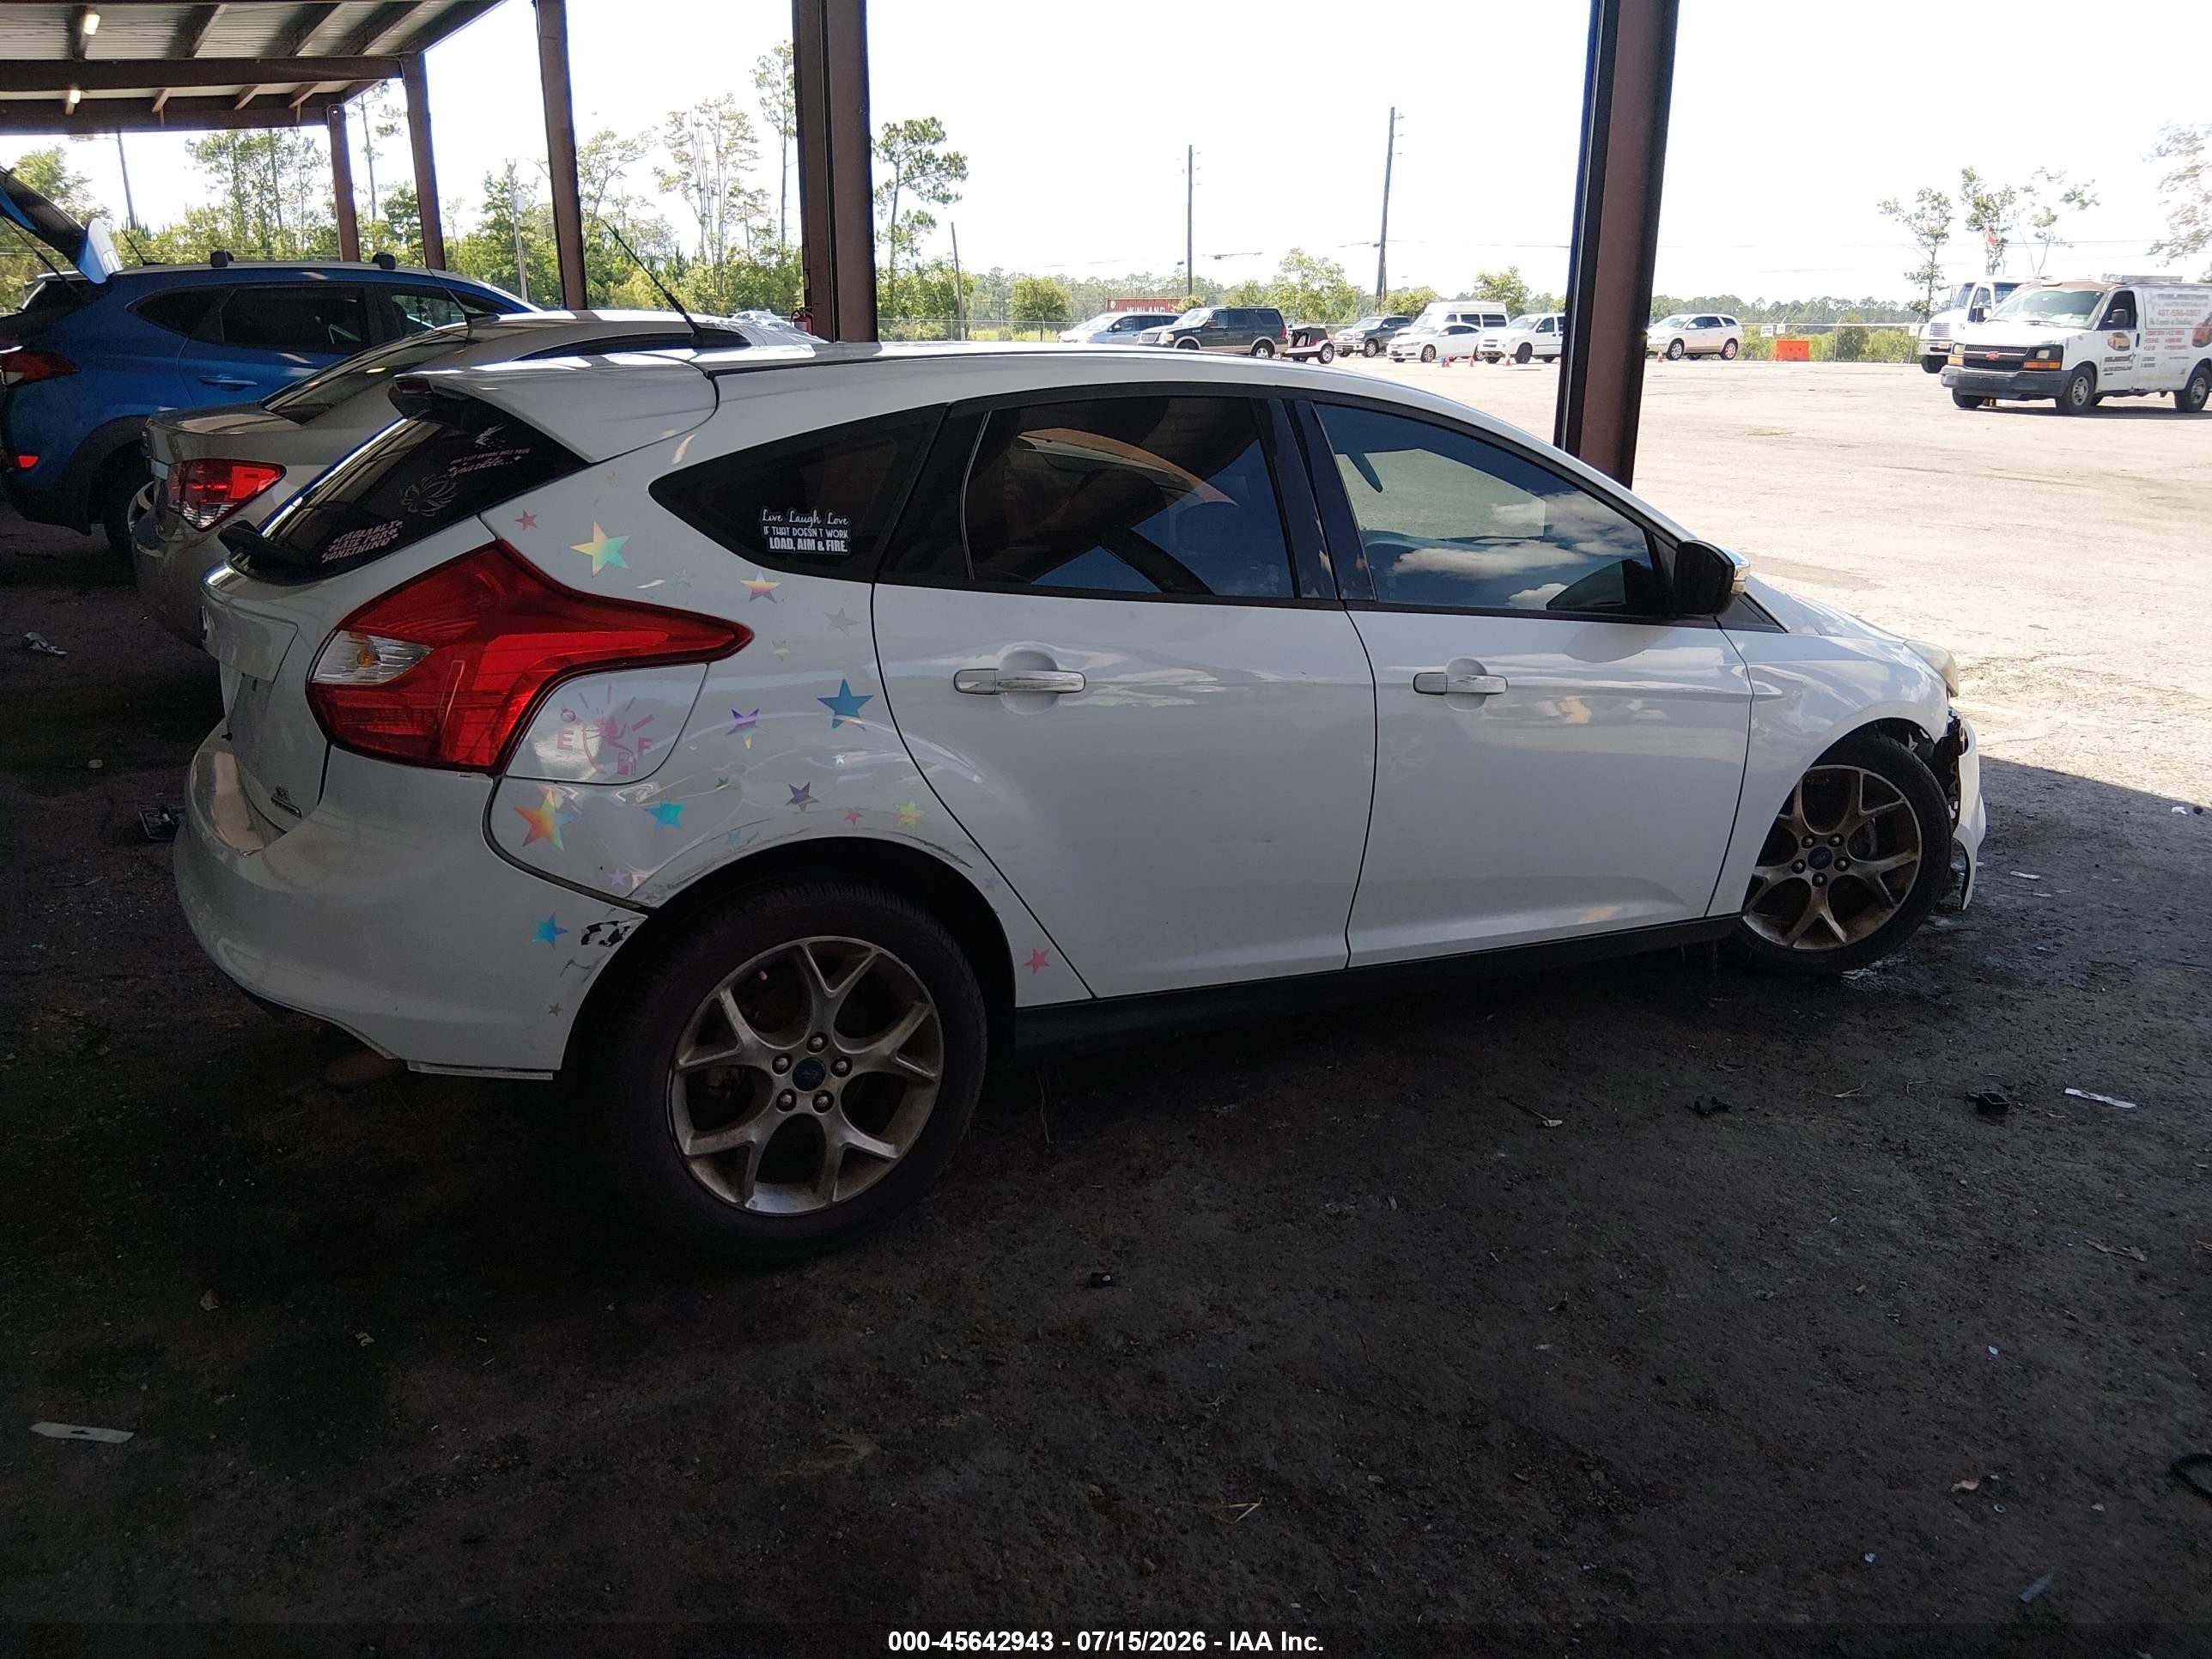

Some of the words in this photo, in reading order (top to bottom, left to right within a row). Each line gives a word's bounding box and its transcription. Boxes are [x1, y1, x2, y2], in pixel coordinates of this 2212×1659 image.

[763, 509, 783, 521] Live
[788, 509, 822, 528] Laugh
[827, 512, 848, 526] Love
[763, 526, 769, 535] IF
[772, 526, 790, 536] THAT
[792, 527, 823, 538] DOESNT
[825, 529, 849, 539] WORK
[769, 537, 796, 551] LOAD,
[798, 538, 816, 550] AIM
[817, 540, 825, 551] &
[557, 730, 574, 750] E
[638, 737, 653, 756] F
